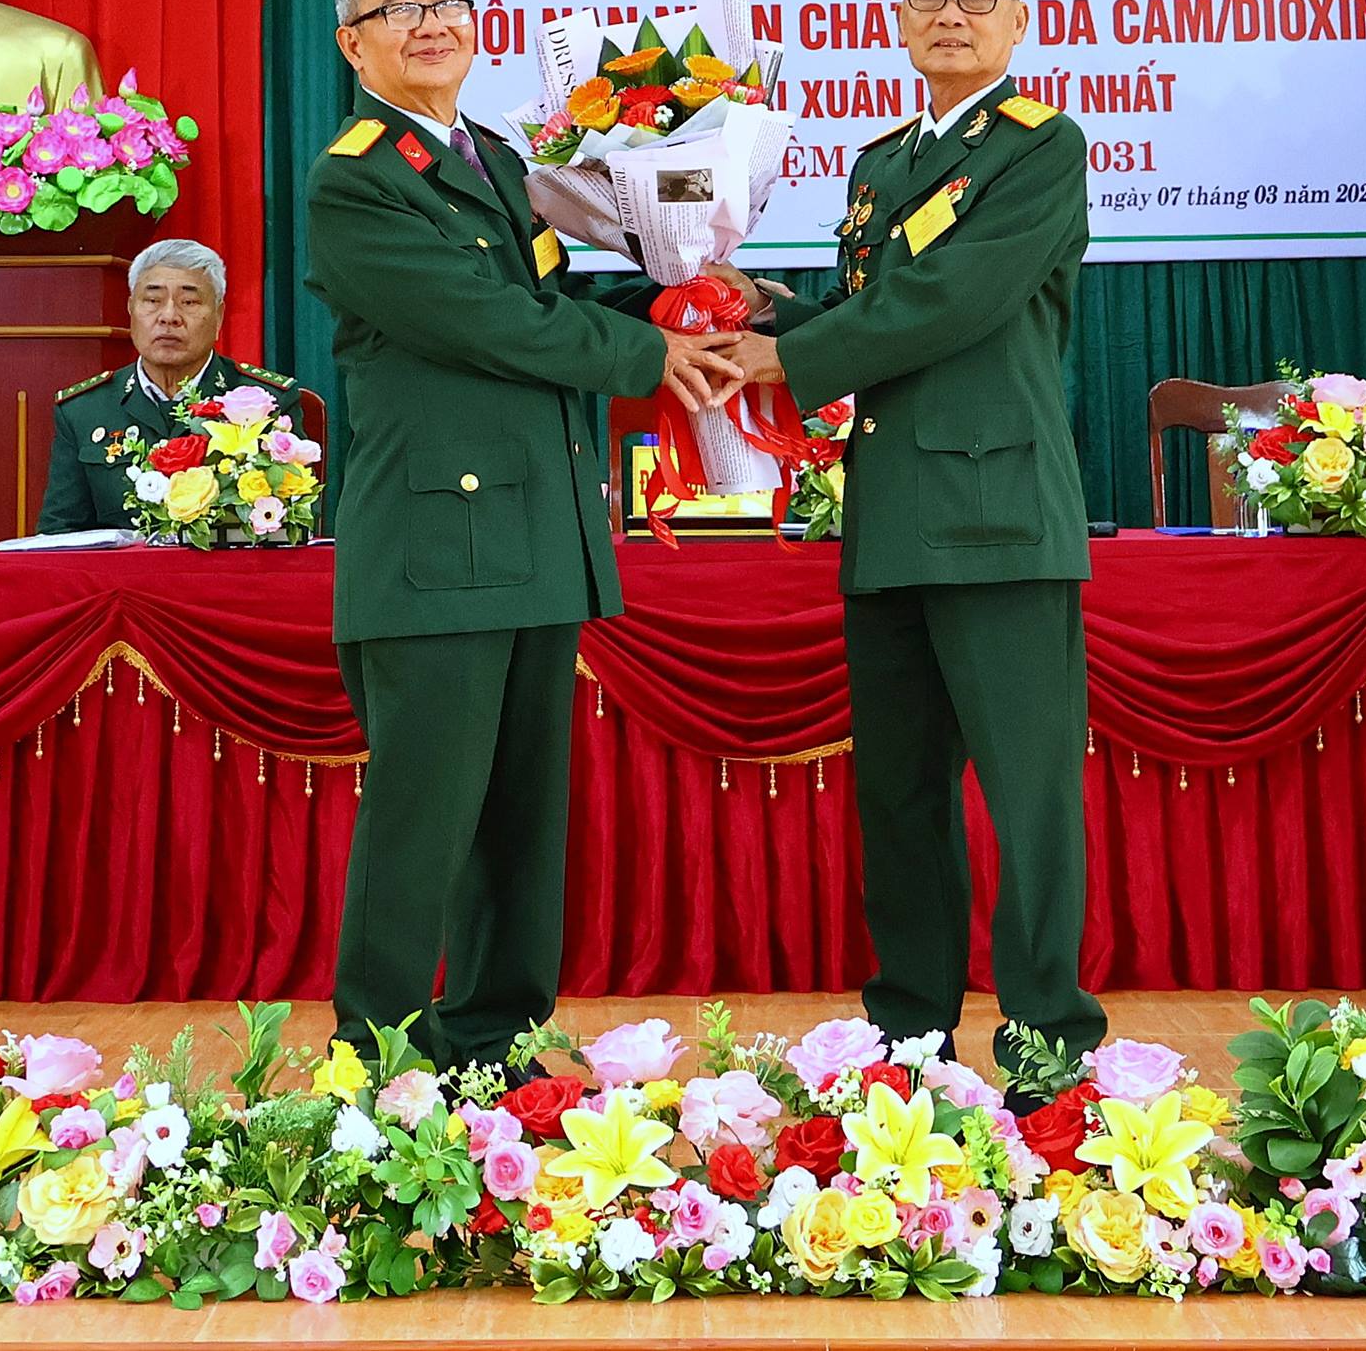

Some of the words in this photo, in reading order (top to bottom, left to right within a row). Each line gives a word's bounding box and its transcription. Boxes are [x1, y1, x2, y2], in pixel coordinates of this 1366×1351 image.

[800, 71, 902, 118] XUÂN
[1080, 59, 1177, 113] NHẤT
[1086, 140, 1157, 173] 031
[1099, 187, 1152, 212] ngày
[1157, 186, 1182, 206] 07
[1187, 185, 1250, 210] tháng
[1254, 184, 1278, 205] 03
[1284, 184, 1330, 204] năm
